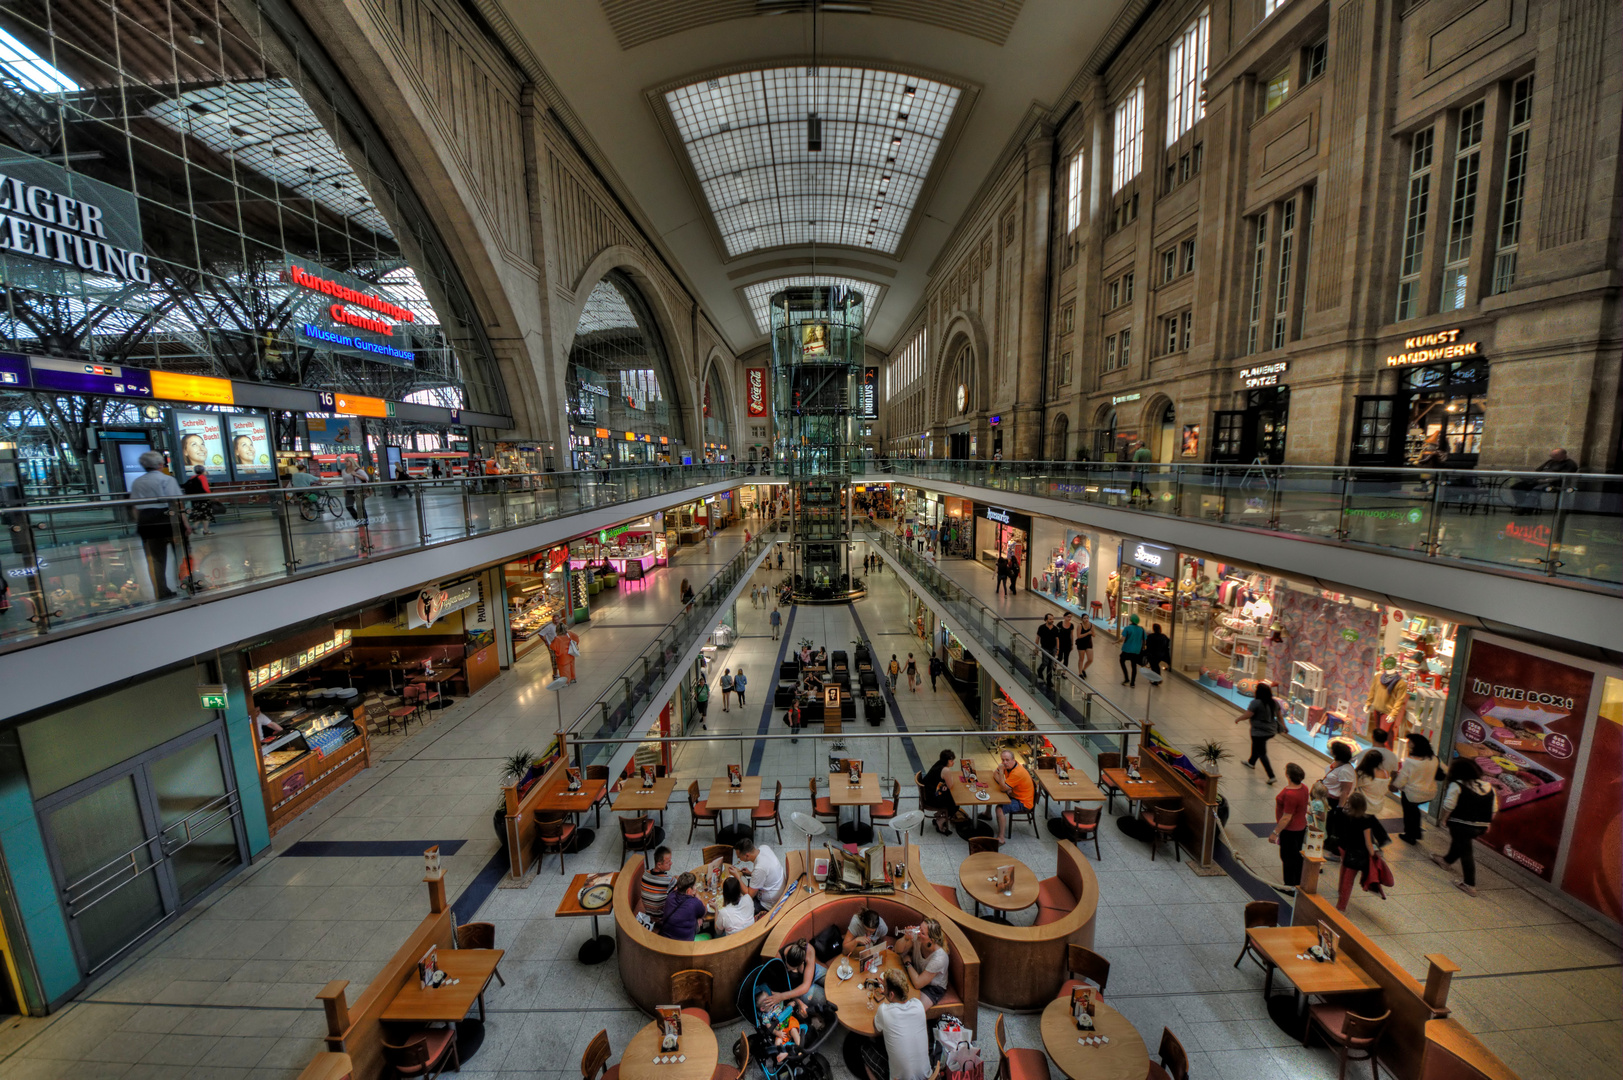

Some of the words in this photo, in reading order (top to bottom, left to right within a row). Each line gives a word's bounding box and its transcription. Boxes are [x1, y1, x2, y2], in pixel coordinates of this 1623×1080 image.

[291, 265, 415, 322] Kunstsammlungen
[330, 304, 394, 336] Chemnitz
[305, 324, 352, 347] Museum
[353, 336, 415, 361] Gunzenhauser
[1404, 329, 1460, 350] KUNST
[1387, 342, 1478, 367] HANDWERK
[1239, 362, 1287, 379] PLAUENER
[1245, 375, 1278, 388] SPITZE
[320, 392, 333, 406] 16
[864, 384, 874, 414] SATURN
[182, 419, 207, 428] Schreib!
[450, 409, 457, 418] 17
[233, 421, 255, 429] Schreib!
[1472, 678, 1490, 695] IN
[1494, 685, 1524, 701] THE
